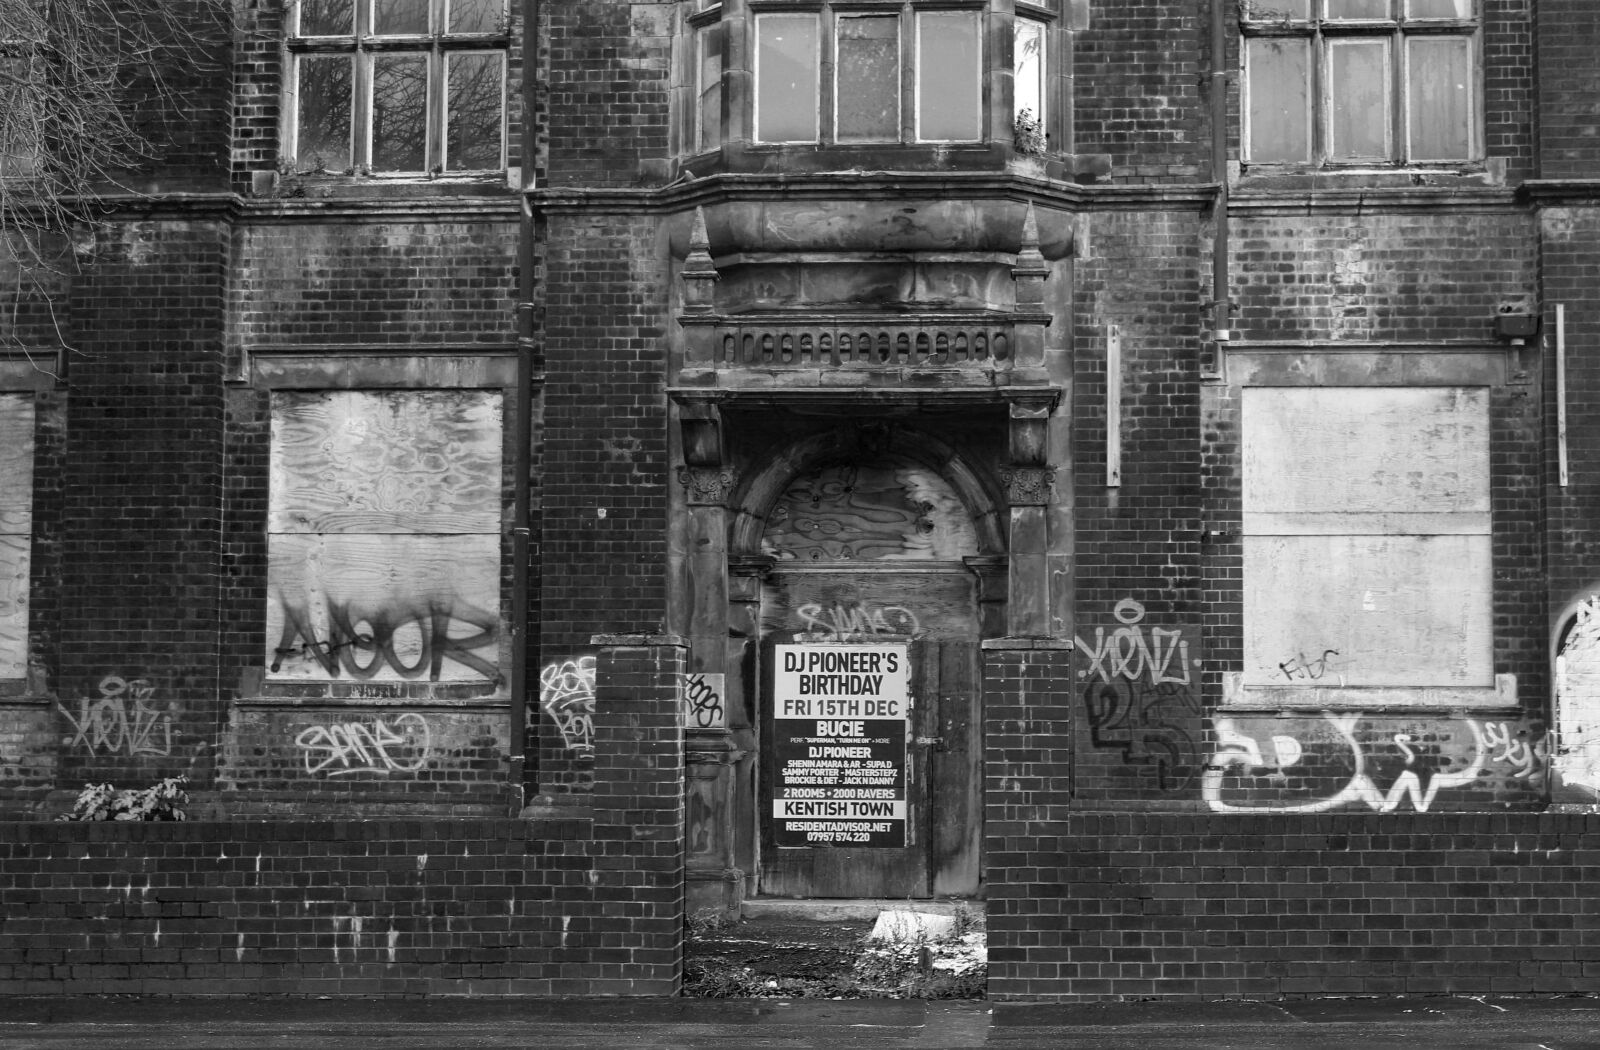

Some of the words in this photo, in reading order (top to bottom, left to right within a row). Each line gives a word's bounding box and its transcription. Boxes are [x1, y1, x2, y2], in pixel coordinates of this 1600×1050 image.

[784, 652, 805, 673] DJ
[809, 652, 898, 673] PIONEER'S
[800, 674, 883, 695] BIRTHDAY
[783, 700, 811, 715] FRI
[817, 700, 859, 716] 15TH
[864, 700, 899, 716] DEC
[816, 720, 865, 737] BUCIE
[809, 746, 822, 758] DJ
[823, 746, 872, 758] PIONEER
[787, 760, 815, 768] SHENIN
[816, 760, 842, 768] AMARA
[843, 760, 849, 768] &
[850, 760, 860, 768] AR
[782, 768, 809, 776] SAMMY
[810, 768, 839, 776] PORTER
[845, 768, 898, 777] MASTERSTEPZ
[784, 776, 816, 785] BROCKIE
[817, 776, 823, 785] &
[823, 777, 838, 785] DET
[842, 777, 862, 785] JACK
[862, 777, 868, 785] N
[869, 777, 895, 785] DANNY
[783, 788, 790, 798] 2
[791, 788, 825, 798] ROOMS
[833, 788, 856, 799] 2000
[857, 788, 895, 799] RAVERS
[784, 801, 848, 816] KENTISH
[850, 802, 894, 816] TOWN
[785, 821, 892, 832] RESIDENTADVISOR.NET
[807, 832, 834, 841] 07957
[835, 832, 852, 842] 574
[853, 832, 870, 842] 220
